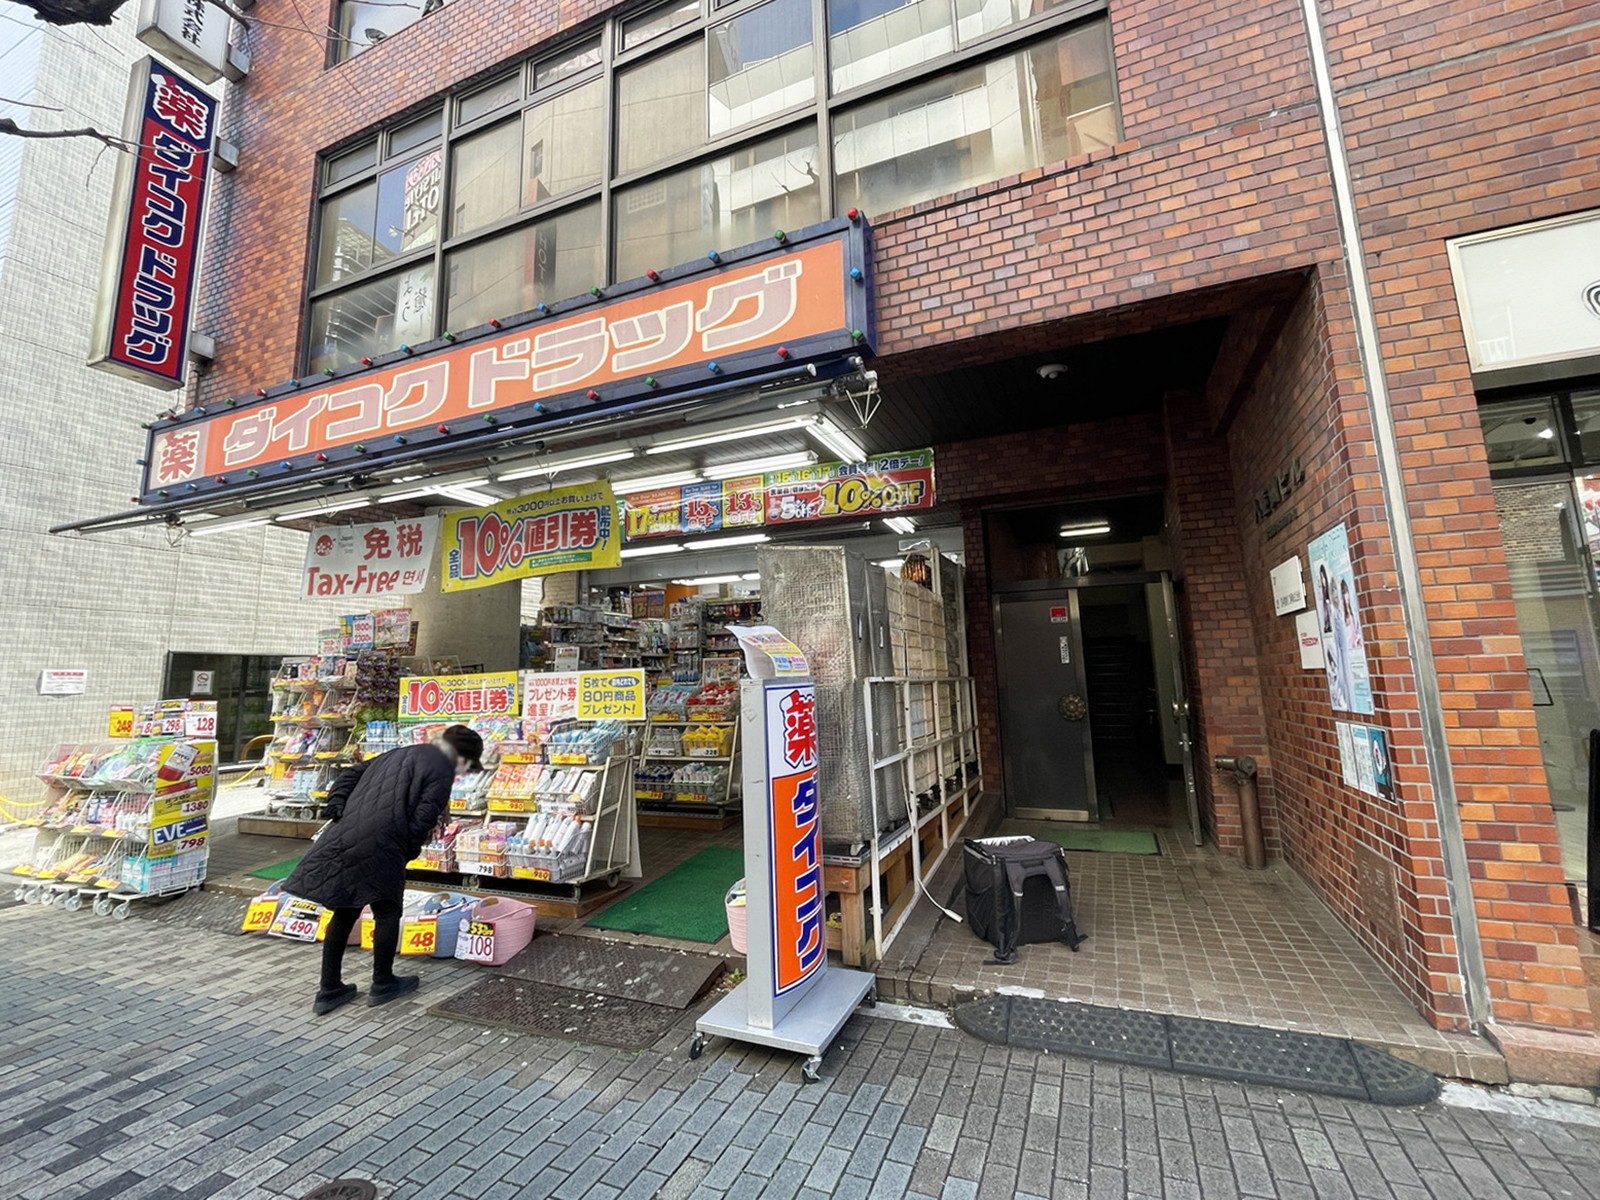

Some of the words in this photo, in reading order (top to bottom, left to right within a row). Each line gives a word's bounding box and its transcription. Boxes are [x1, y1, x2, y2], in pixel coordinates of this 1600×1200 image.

[151, 73, 209, 140] 薬
[157, 430, 200, 484] 薬
[363, 523, 423, 560] 免税
[459, 510, 599, 577] 10%値引券
[307, 564, 400, 596] Tax-Free
[409, 680, 508, 715] 10%値引券
[583, 690, 636, 702] 80円商品
[780, 689, 818, 769] 薬
[153, 822, 187, 845] EVE
[250, 911, 273, 925] 128
[290, 920, 313, 935] 490
[409, 931, 435, 947] 48
[469, 936, 492, 956] 108
